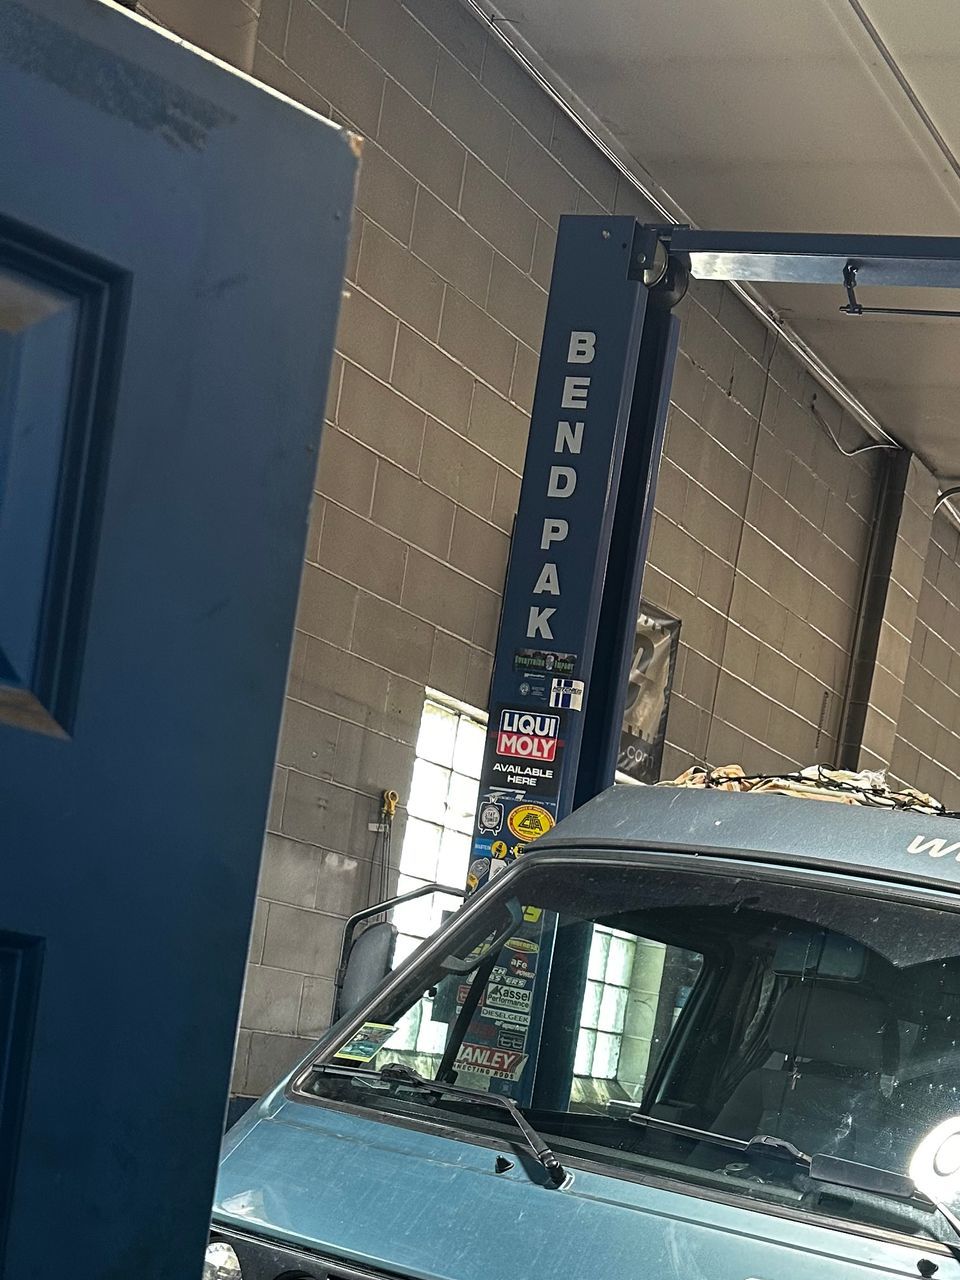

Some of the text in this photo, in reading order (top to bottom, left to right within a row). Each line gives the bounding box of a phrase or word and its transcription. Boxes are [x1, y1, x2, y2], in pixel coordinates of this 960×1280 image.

[502, 713, 556, 737] LIQUI
[500, 733, 556, 758] MOLY
[493, 763, 553, 778] AVAILABLE
[507, 775, 537, 786] HERE
[487, 993, 530, 1008] Performance
[498, 985, 531, 1001] Kassel
[482, 1007, 529, 1023] DIESELGEEK
[456, 1045, 516, 1069] ANLEY
[493, 1069, 514, 1080] RODS
